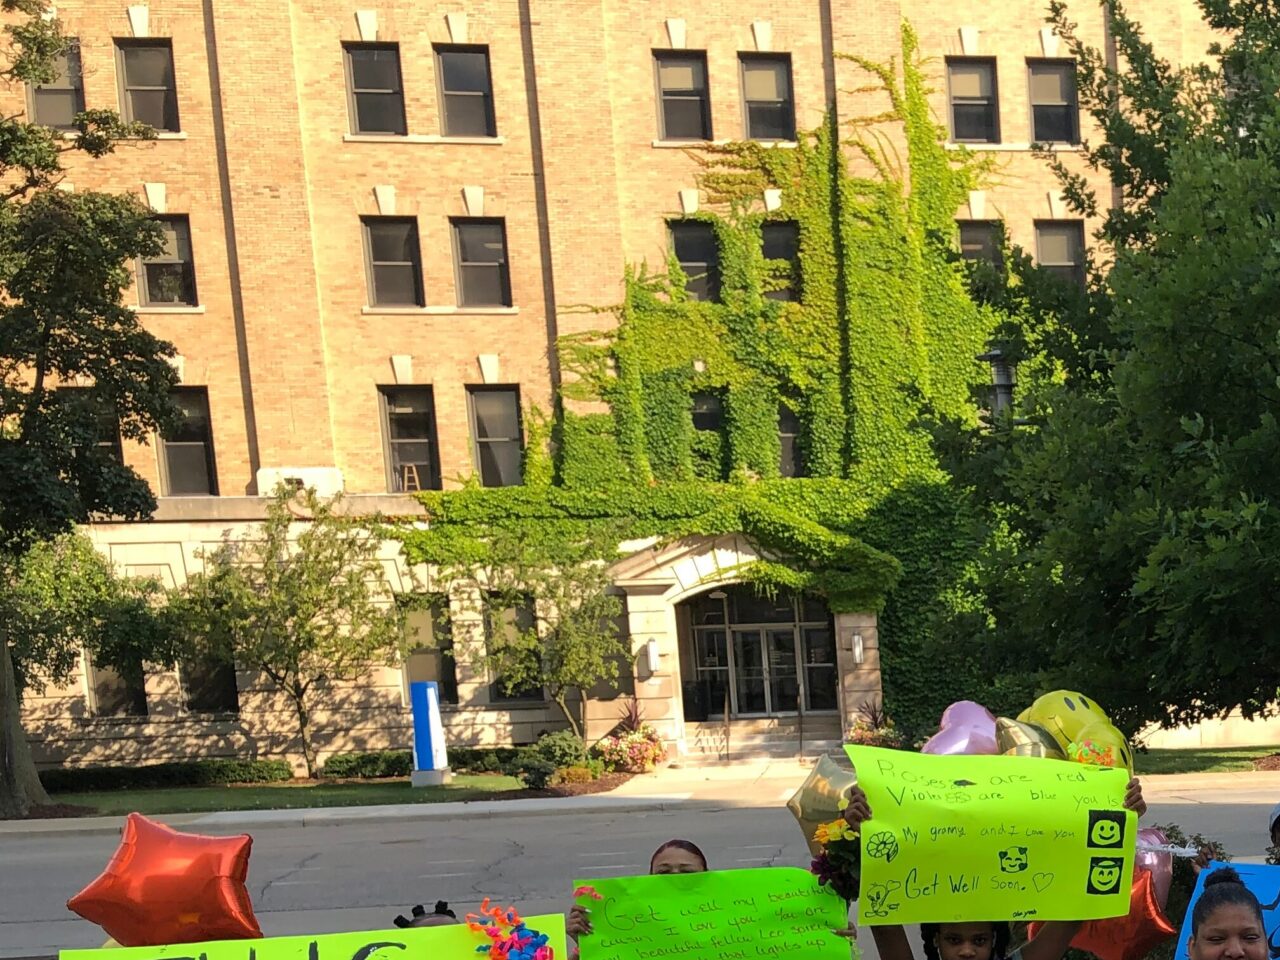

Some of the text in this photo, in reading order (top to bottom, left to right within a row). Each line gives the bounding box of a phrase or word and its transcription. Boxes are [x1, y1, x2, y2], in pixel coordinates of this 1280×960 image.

[990, 775, 1032, 786] are
[1056, 772, 1087, 783] red
[978, 792, 1004, 800] are
[1030, 790, 1057, 800] blue
[905, 868, 940, 900] Get
[949, 874, 980, 894] Well
[604, 897, 668, 931] Get
